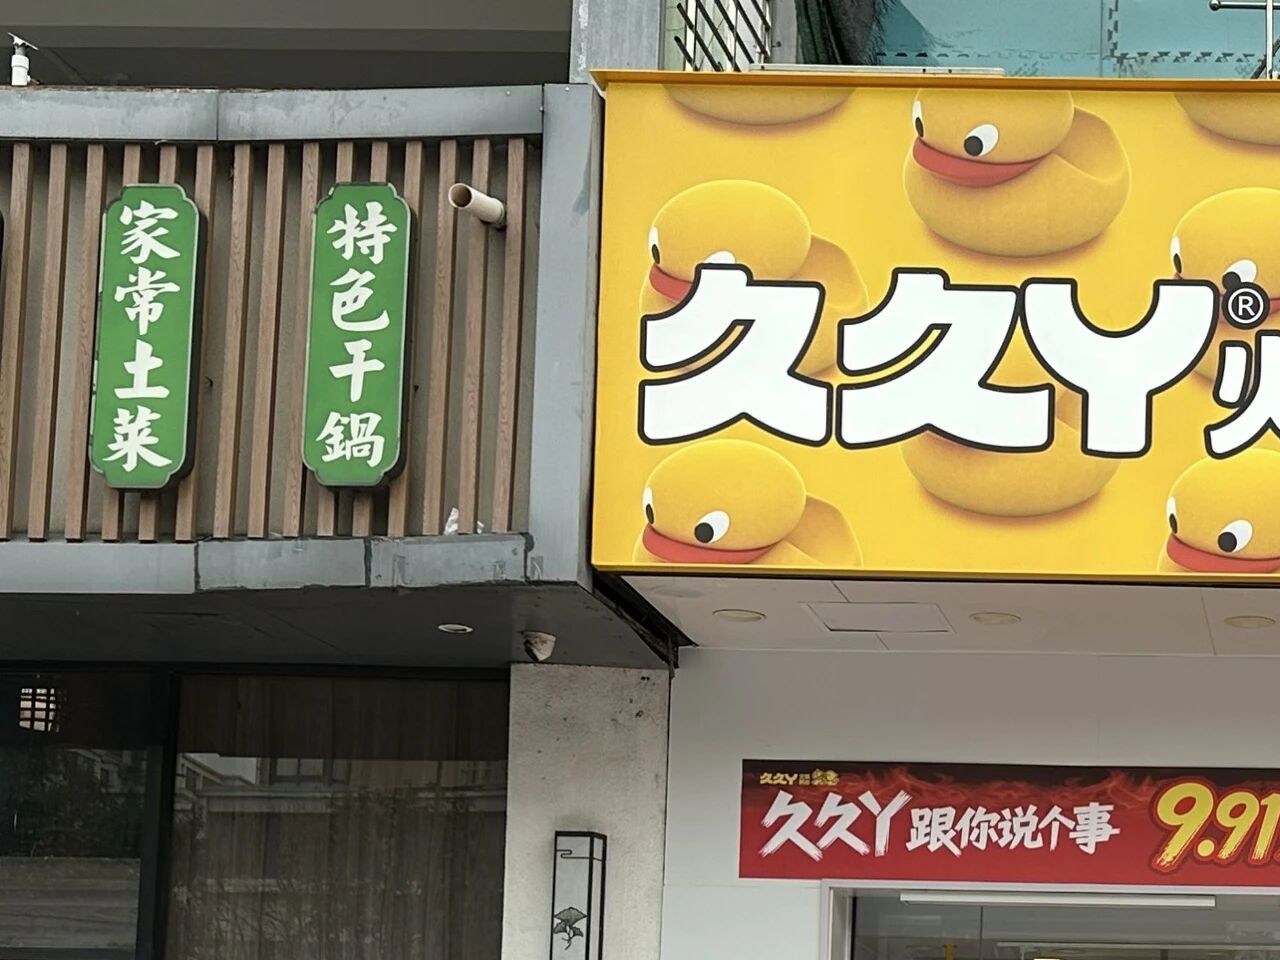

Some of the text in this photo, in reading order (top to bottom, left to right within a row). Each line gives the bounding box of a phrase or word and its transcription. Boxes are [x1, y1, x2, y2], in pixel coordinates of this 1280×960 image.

[103, 200, 181, 473] 家常土菜
[316, 201, 398, 469] 特色干鍋
